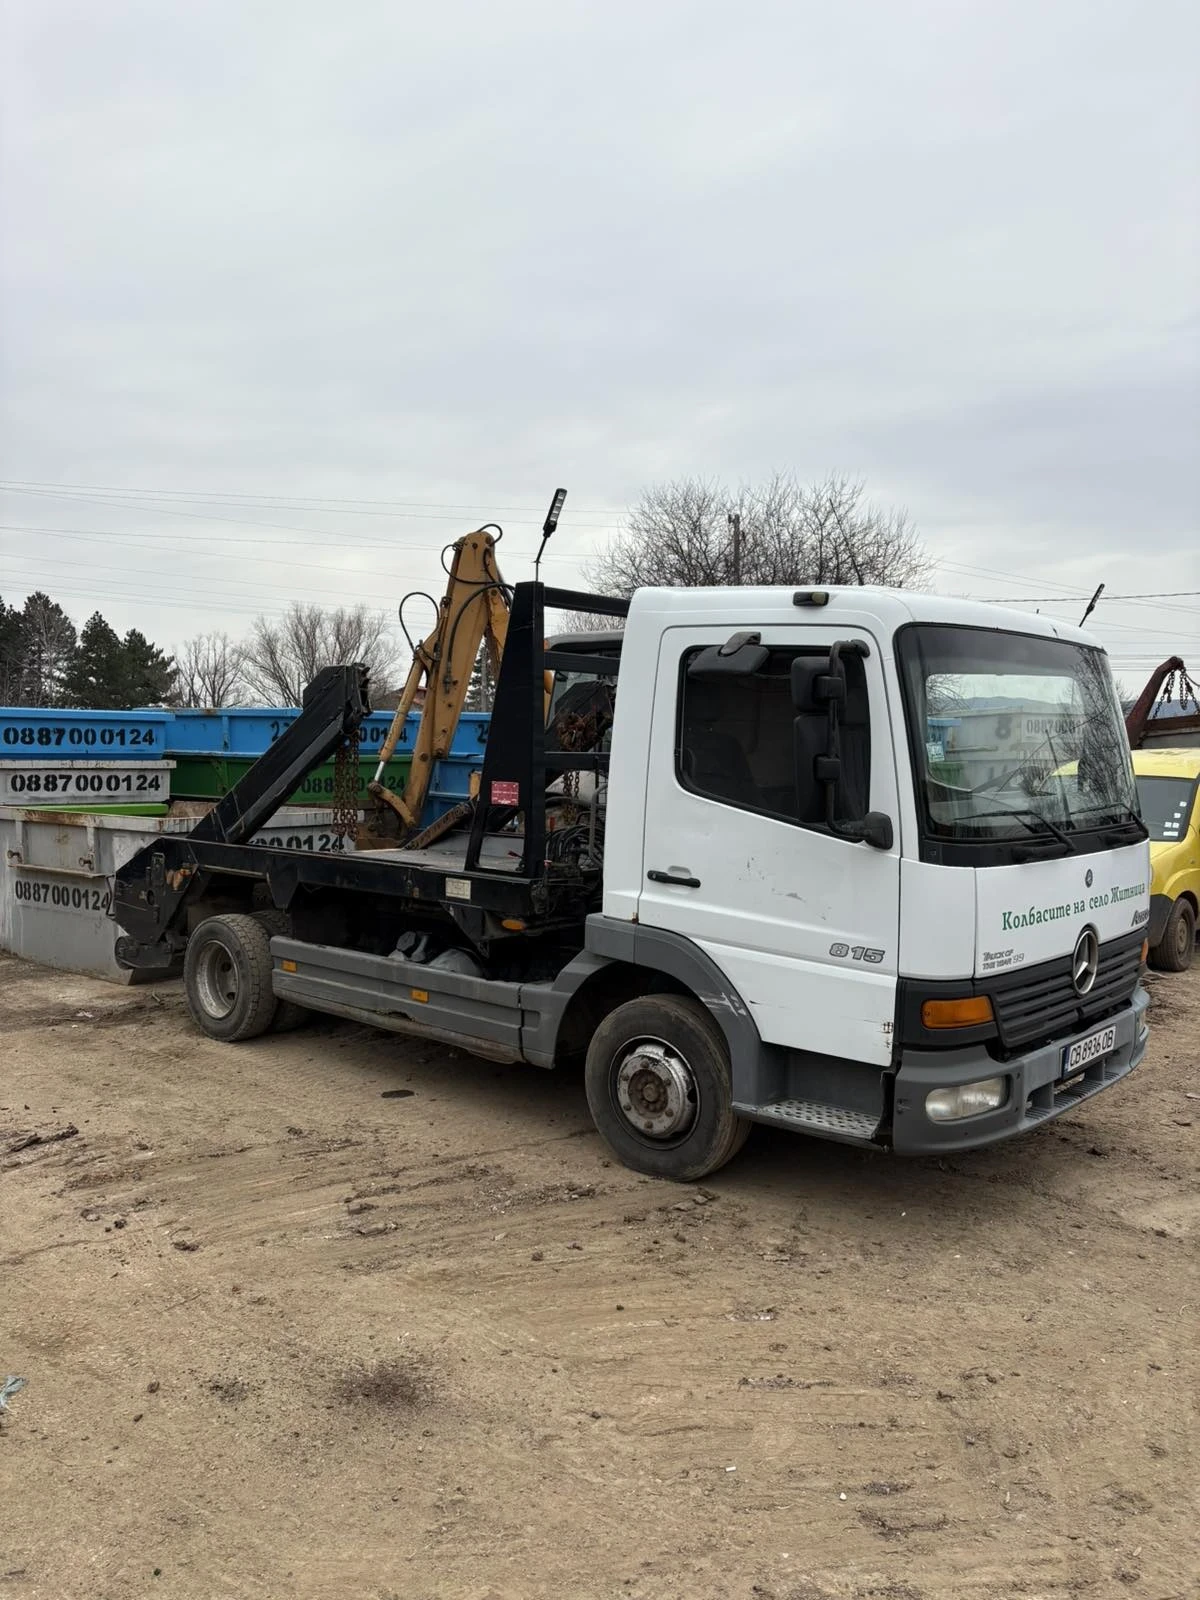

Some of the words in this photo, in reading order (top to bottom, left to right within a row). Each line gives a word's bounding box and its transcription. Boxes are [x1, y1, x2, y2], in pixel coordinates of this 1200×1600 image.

[3, 727, 155, 746] 0887000124
[10, 774, 161, 792] 0887000124
[15, 880, 110, 911] 0887000124
[1002, 906, 1071, 931] Колбасите
[1073, 900, 1085, 914] на
[1089, 894, 1109, 910] село
[829, 943, 885, 964] 815
